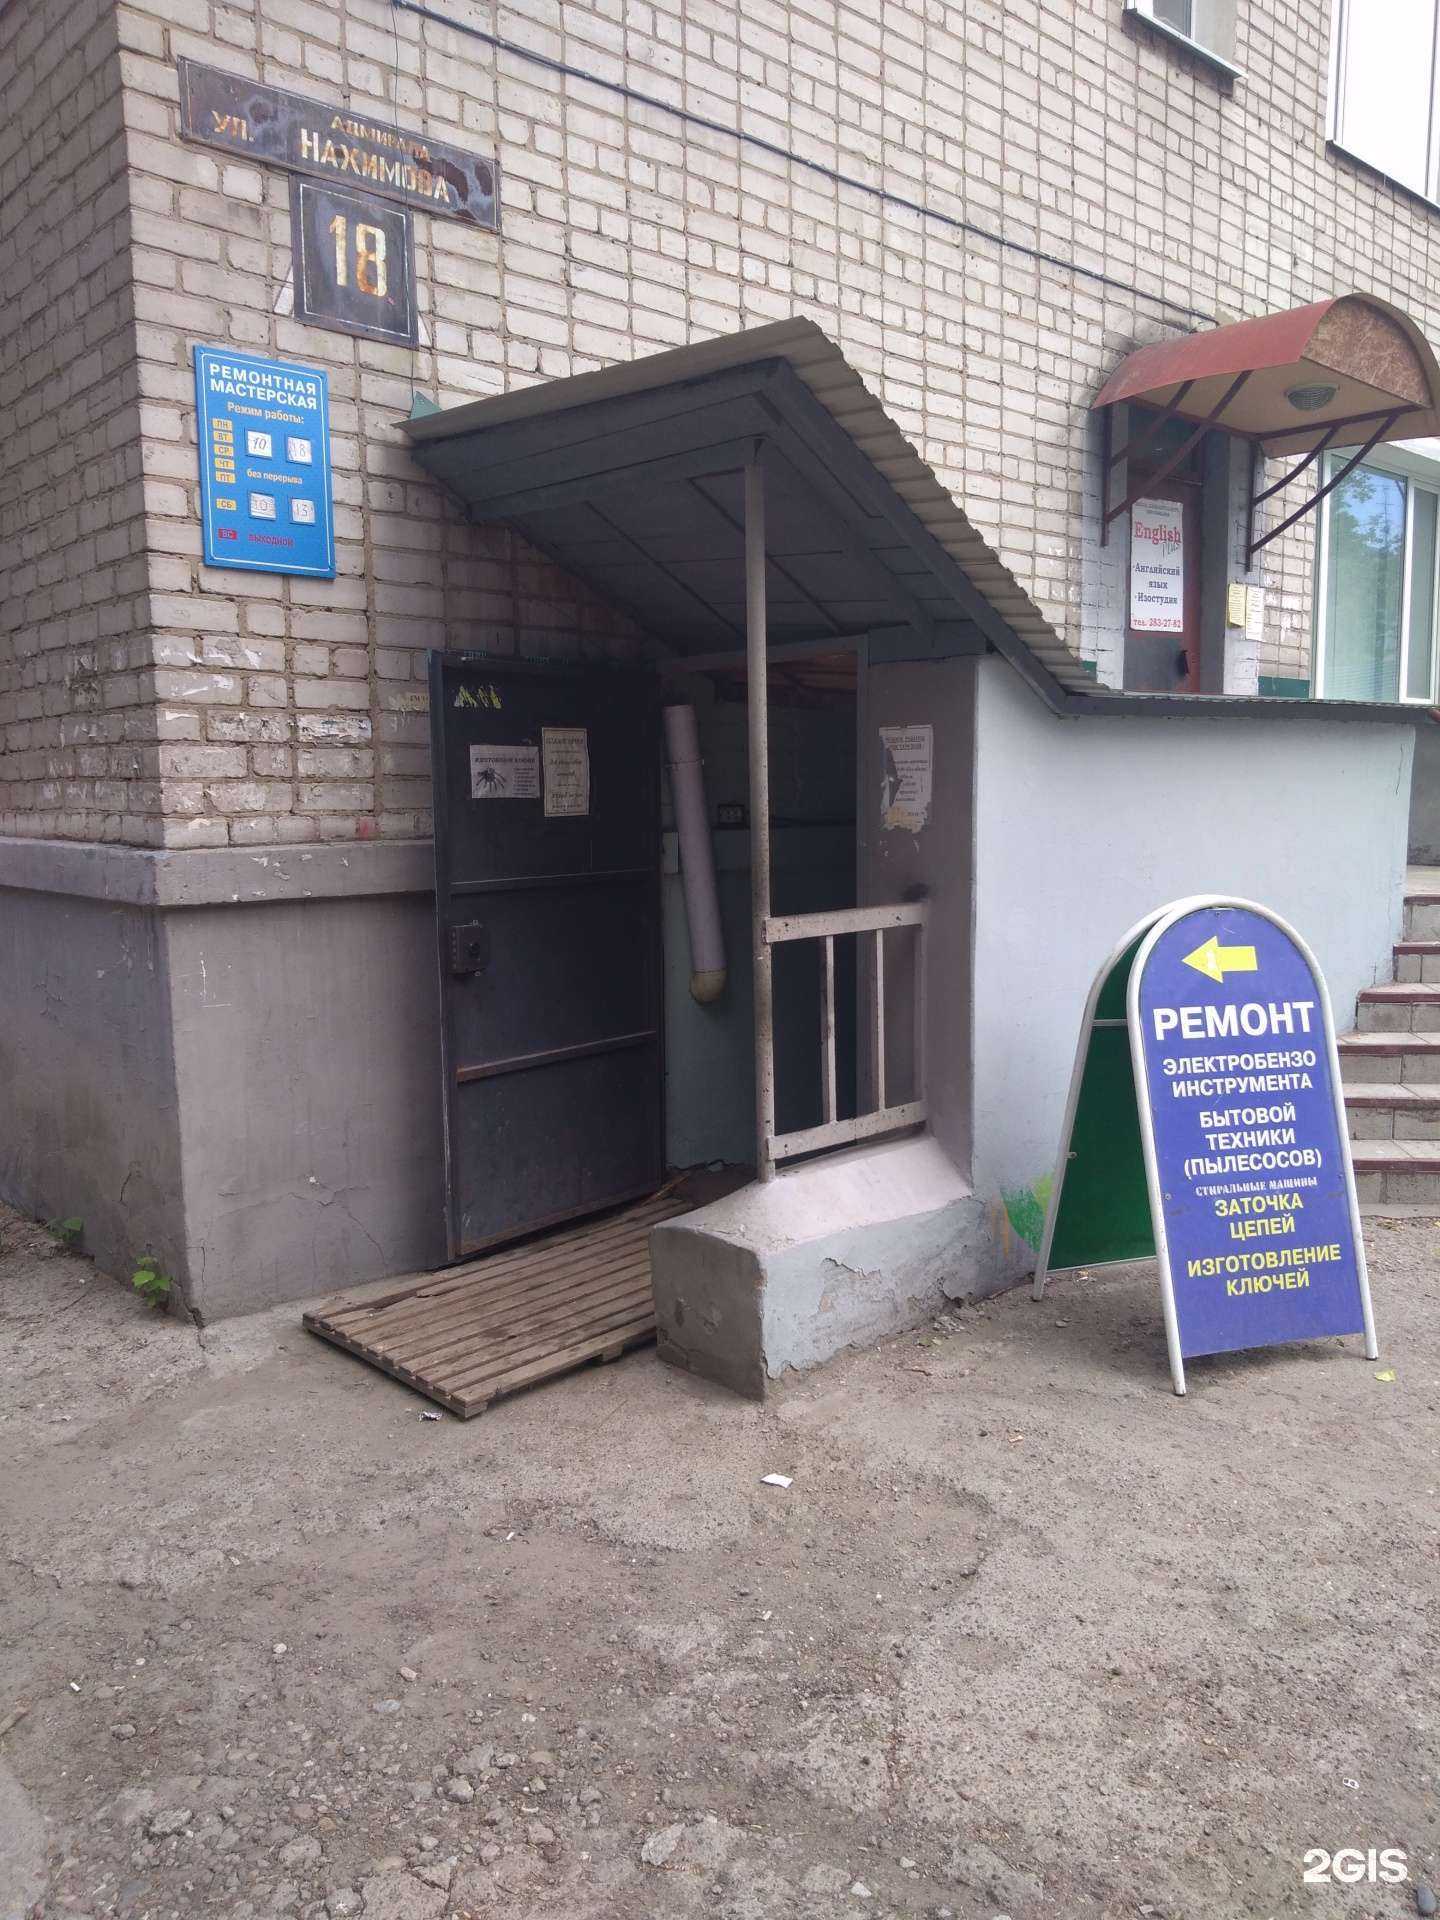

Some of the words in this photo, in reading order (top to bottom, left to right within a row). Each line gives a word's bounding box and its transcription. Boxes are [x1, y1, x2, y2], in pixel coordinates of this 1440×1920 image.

[300, 128, 450, 203] НАХИМОВА
[329, 214, 387, 297] 18
[209, 363, 317, 396] РЕМОНТНАЯ
[209, 378, 318, 410] МАСТЕРСКАЯ
[227, 401, 263, 418] Режим
[264, 407, 305, 425] работы:
[246, 467, 262, 478] без
[263, 471, 303, 486] перерыва
[1134, 521, 1182, 545] English
[1135, 562, 1180, 576] Английский
[1153, 1001, 1314, 1041] РЕМОНТ
[1162, 1050, 1317, 1076] ЭЛЕКТРОБЕНЗО
[1172, 1073, 1313, 1098] ИНСТРУМЕНТА
[1200, 1102, 1296, 1128] БЫТОВОЙ
[1205, 1128, 1295, 1151] ТЕХНИКИ
[1184, 1148, 1322, 1180] (ПЫЛЕСОСОВ)
[1195, 1180, 1267, 1197] СТИРАЛЬНЫЕ
[1269, 1176, 1318, 1191] МАШИНЫ
[1215, 1192, 1304, 1217] ЗАТОЧКА
[1229, 1214, 1295, 1241] ЦЕПЕЙ
[1187, 1243, 1342, 1278] ИЗГОТОВЛЕНИЕ
[1226, 1268, 1310, 1297] КЛЮЧЕЙ
